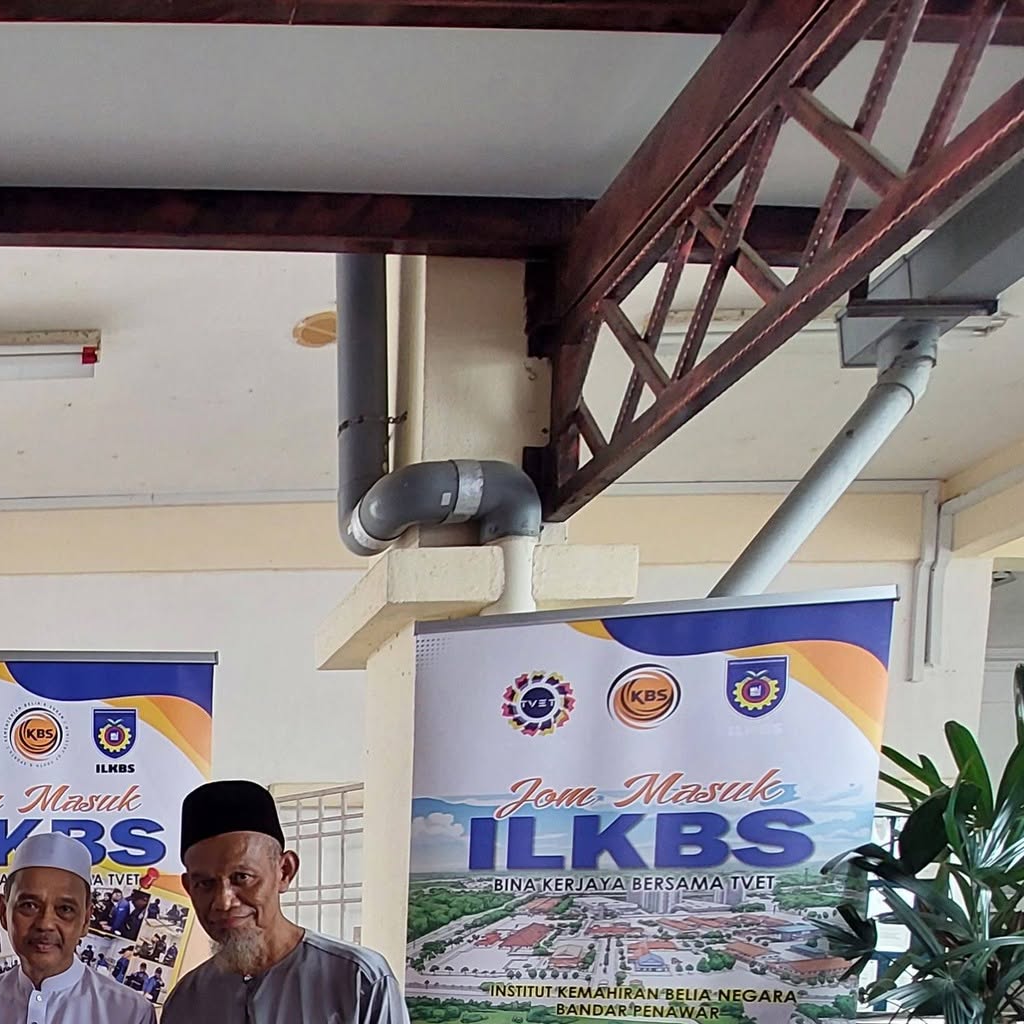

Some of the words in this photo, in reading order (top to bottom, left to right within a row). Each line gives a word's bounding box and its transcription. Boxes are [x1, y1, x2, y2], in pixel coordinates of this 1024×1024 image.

[519, 698, 555, 708] TVET
[631, 688, 668, 703] KBS
[27, 728, 53, 741] KBS
[96, 764, 135, 773] ILKBS
[18, 783, 143, 814] Masuk
[495, 776, 597, 820] Jom
[613, 768, 783, 807] Masuk
[469, 809, 815, 871] ILKBS
[108, 874, 140, 886] TVET
[494, 877, 537, 892] BINA
[543, 876, 626, 892] KERJAYA
[632, 875, 725, 891] BERSAMA
[730, 875, 776, 890] TVET
[490, 985, 552, 1000] INSTITUT
[558, 985, 659, 1001] KEMAHIRAN
[665, 987, 712, 1002] BELIA
[719, 989, 797, 1004] NEGARA
[556, 1003, 627, 1017] BANDAR
[632, 1005, 721, 1020] PENAWAR
